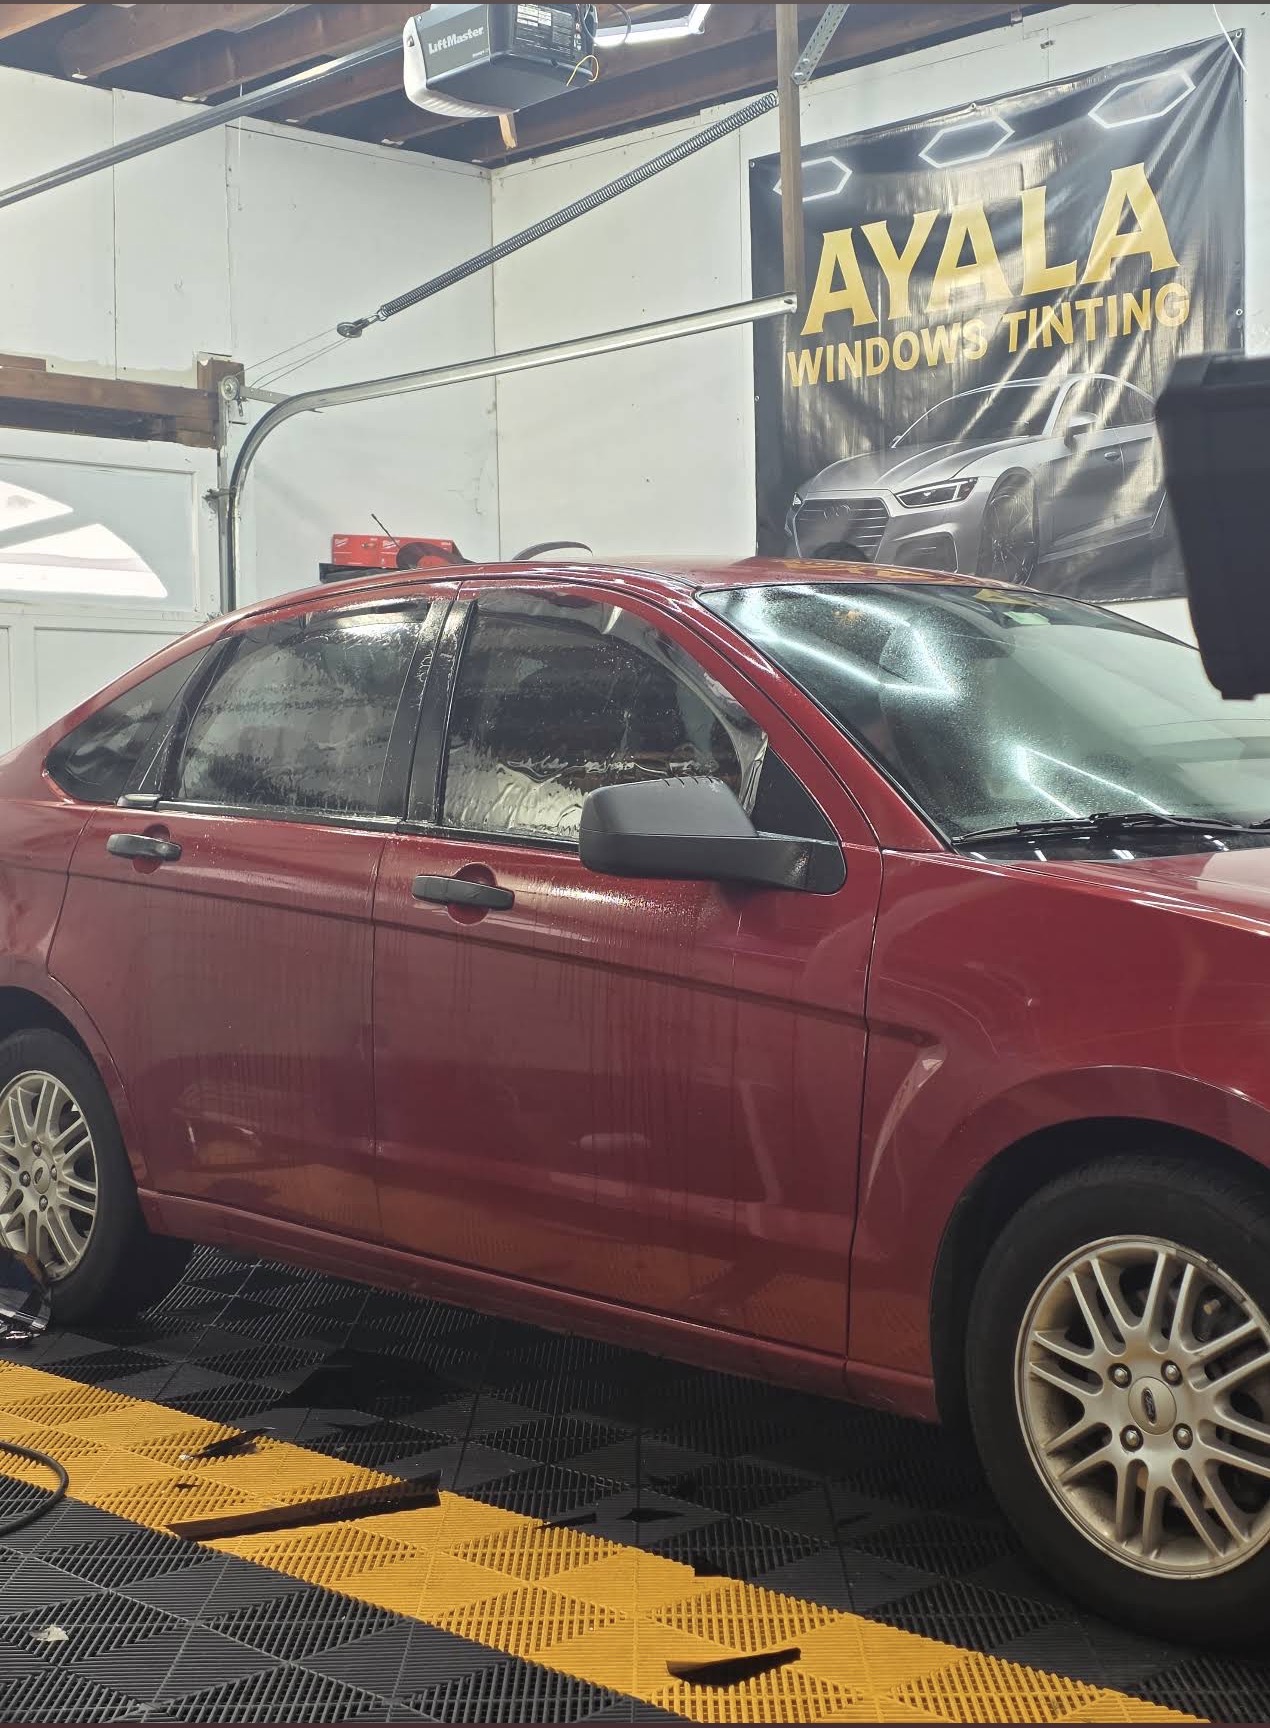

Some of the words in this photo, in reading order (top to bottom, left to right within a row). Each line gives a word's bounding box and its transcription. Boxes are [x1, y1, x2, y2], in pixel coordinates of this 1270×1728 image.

[428, 26, 484, 55] LiftMaster
[800, 162, 1180, 336] AYALA
[787, 320, 988, 387] WINDOWS
[1002, 284, 1190, 353] TINTING
